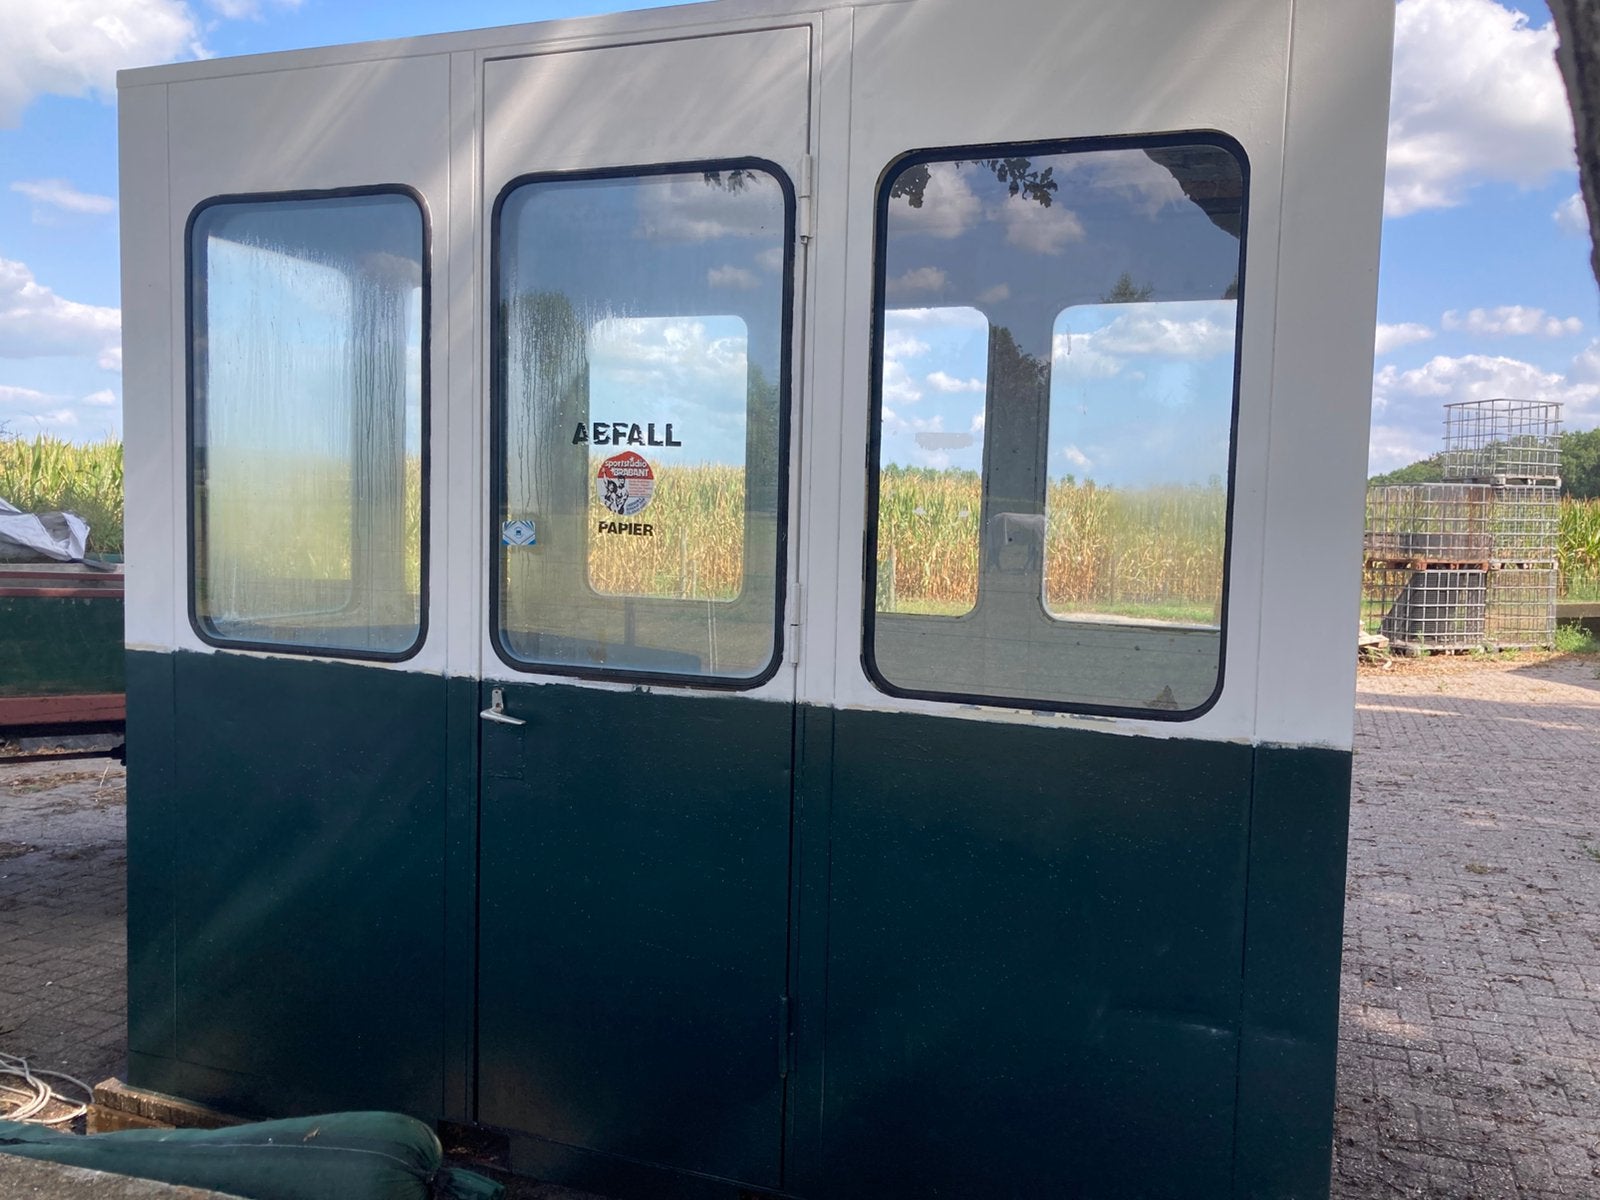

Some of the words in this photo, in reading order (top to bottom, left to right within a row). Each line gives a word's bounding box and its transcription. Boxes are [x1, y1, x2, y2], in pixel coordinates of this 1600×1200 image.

[572, 422, 682, 447] ABFALL
[613, 468, 650, 477] BRABANT
[598, 521, 653, 536] PAPIER
